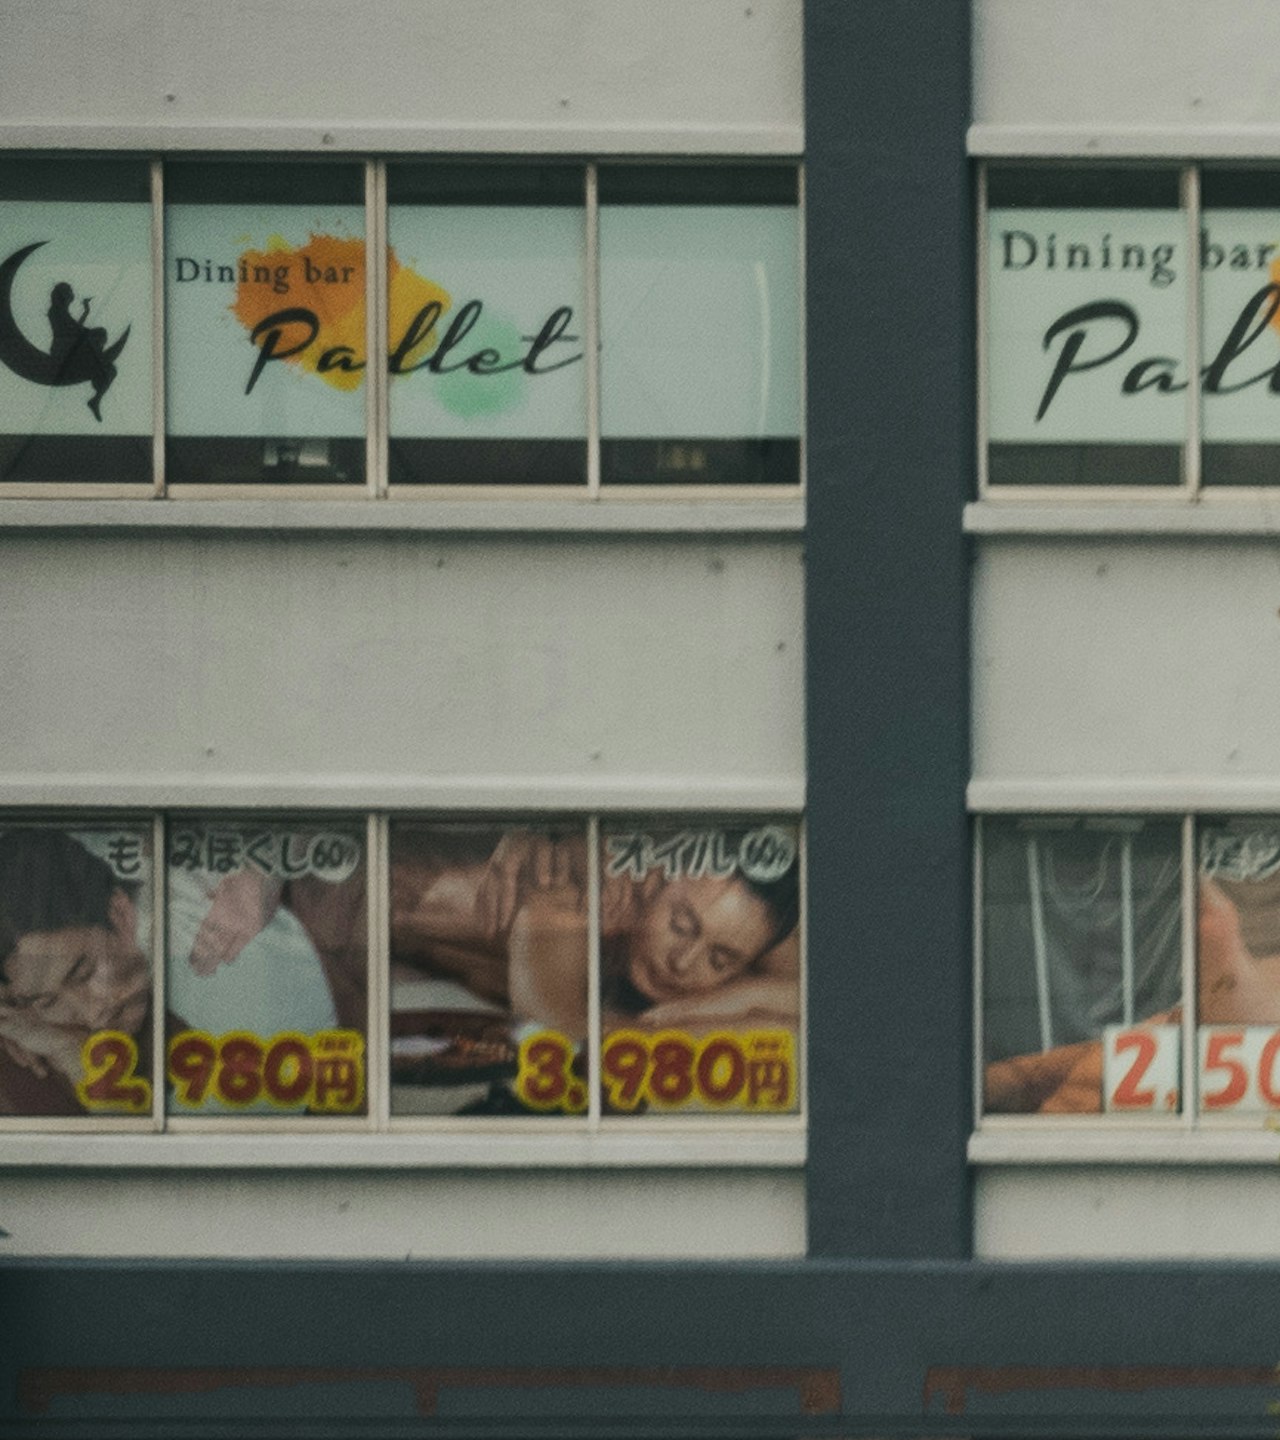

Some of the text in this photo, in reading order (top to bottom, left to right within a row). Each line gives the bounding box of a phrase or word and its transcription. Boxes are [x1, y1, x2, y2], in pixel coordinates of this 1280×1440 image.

[175, 256, 356, 294] Dining bar
[1001, 229, 1279, 286] Dining bar
[244, 300, 584, 396] Pallet
[602, 834, 738, 877] オイル
